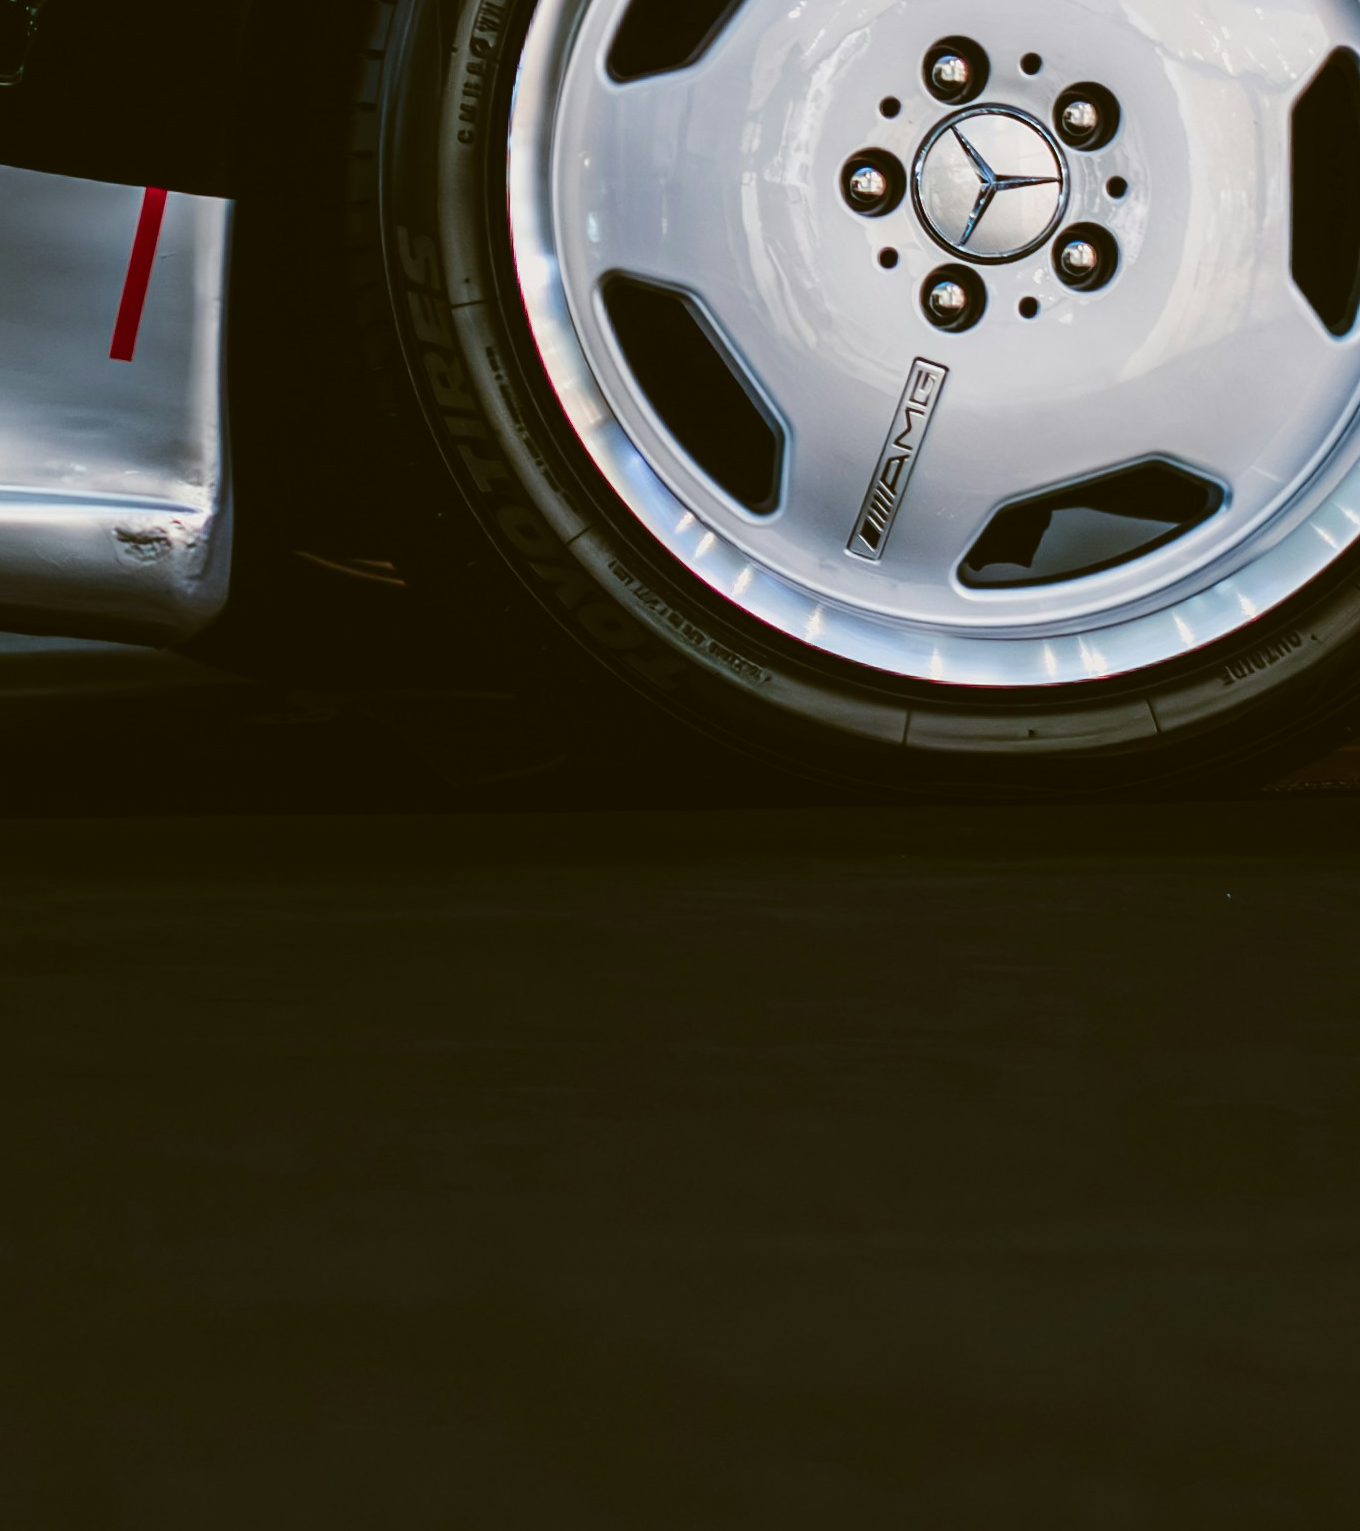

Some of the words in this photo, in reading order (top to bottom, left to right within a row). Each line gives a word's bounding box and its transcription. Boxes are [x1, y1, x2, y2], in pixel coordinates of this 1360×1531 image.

[391, 218, 522, 501] TIRES
[877, 369, 939, 500] AMG
[485, 490, 694, 694] TOYO
